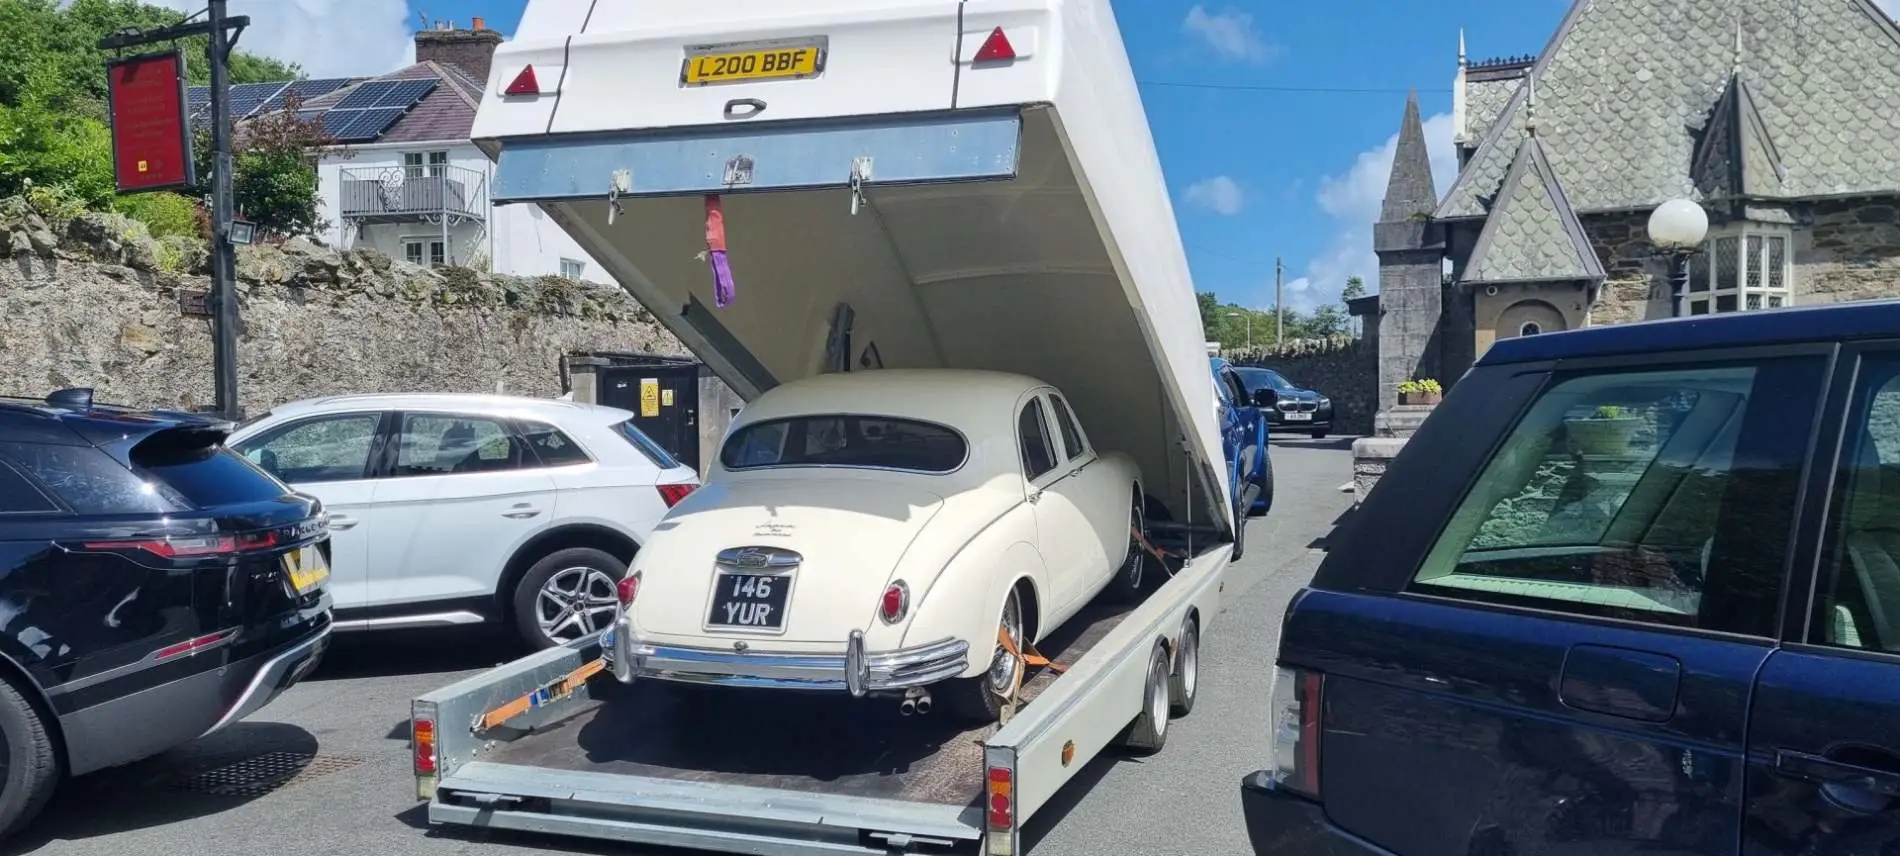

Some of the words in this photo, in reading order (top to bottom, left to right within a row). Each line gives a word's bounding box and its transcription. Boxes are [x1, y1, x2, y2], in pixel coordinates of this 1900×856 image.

[697, 55, 755, 77] L200
[761, 50, 807, 72] BBF
[733, 576, 772, 598] 146
[726, 602, 770, 625] YUR
